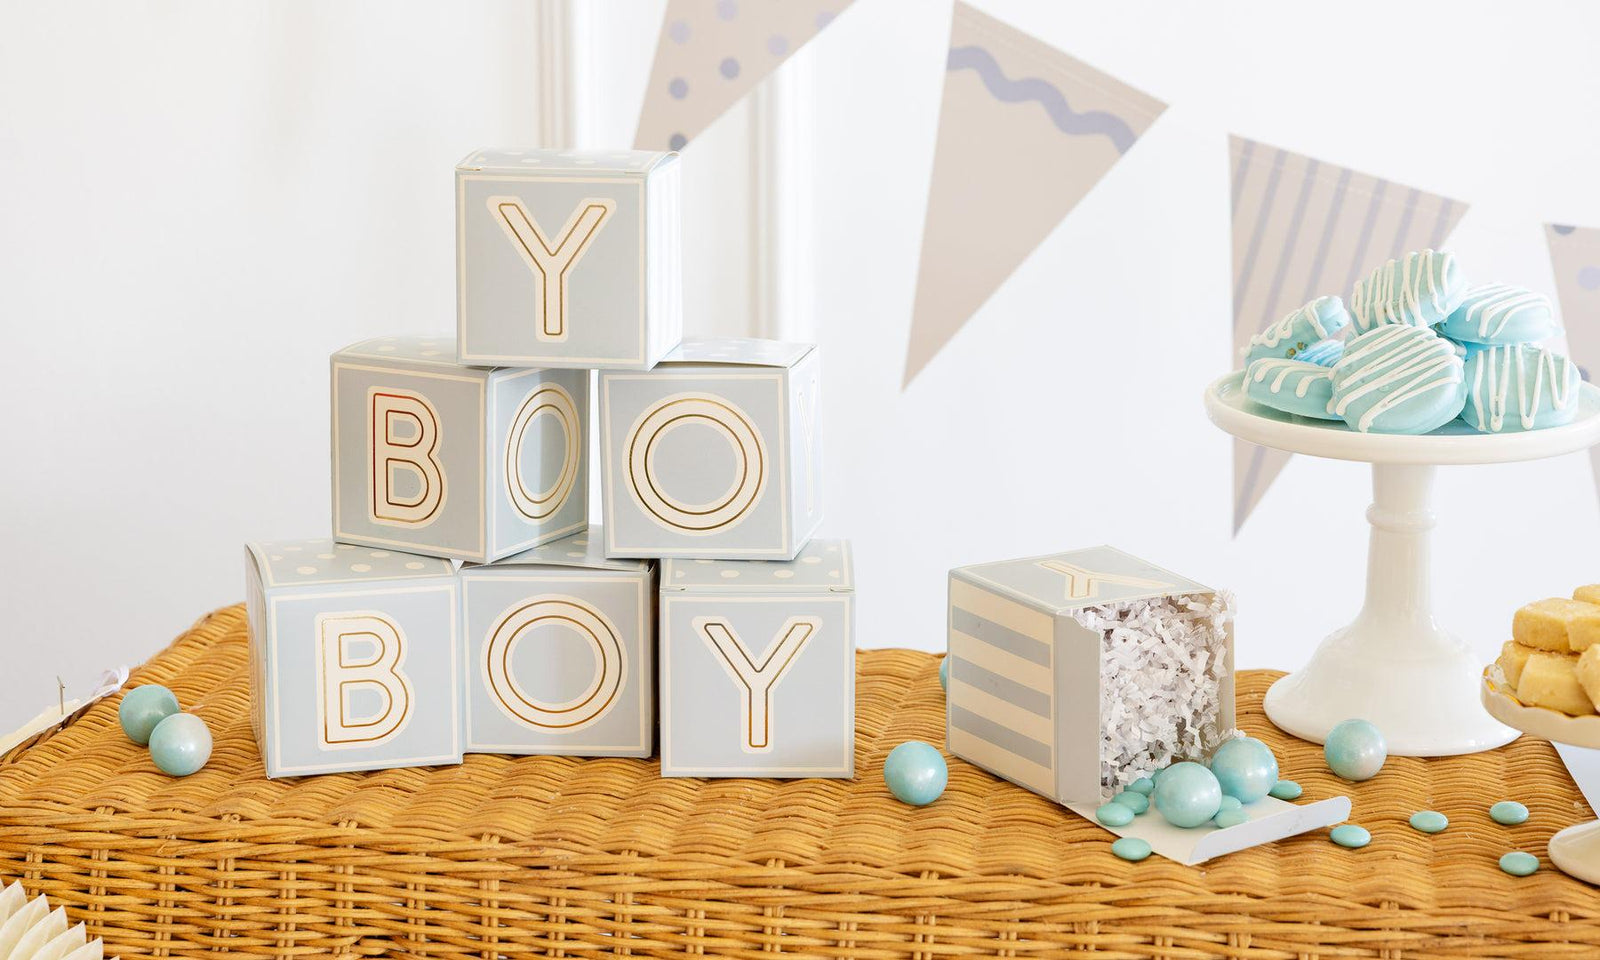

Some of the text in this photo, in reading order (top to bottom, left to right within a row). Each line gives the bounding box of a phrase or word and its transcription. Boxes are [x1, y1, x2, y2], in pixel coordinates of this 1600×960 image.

[487, 196, 616, 342] Y
[368, 386, 448, 528] B
[505, 383, 581, 525] O
[622, 393, 768, 535] O
[1036, 560, 1176, 599] Y
[316, 610, 414, 751] B
[480, 594, 628, 734] O
[692, 616, 823, 753] Y
